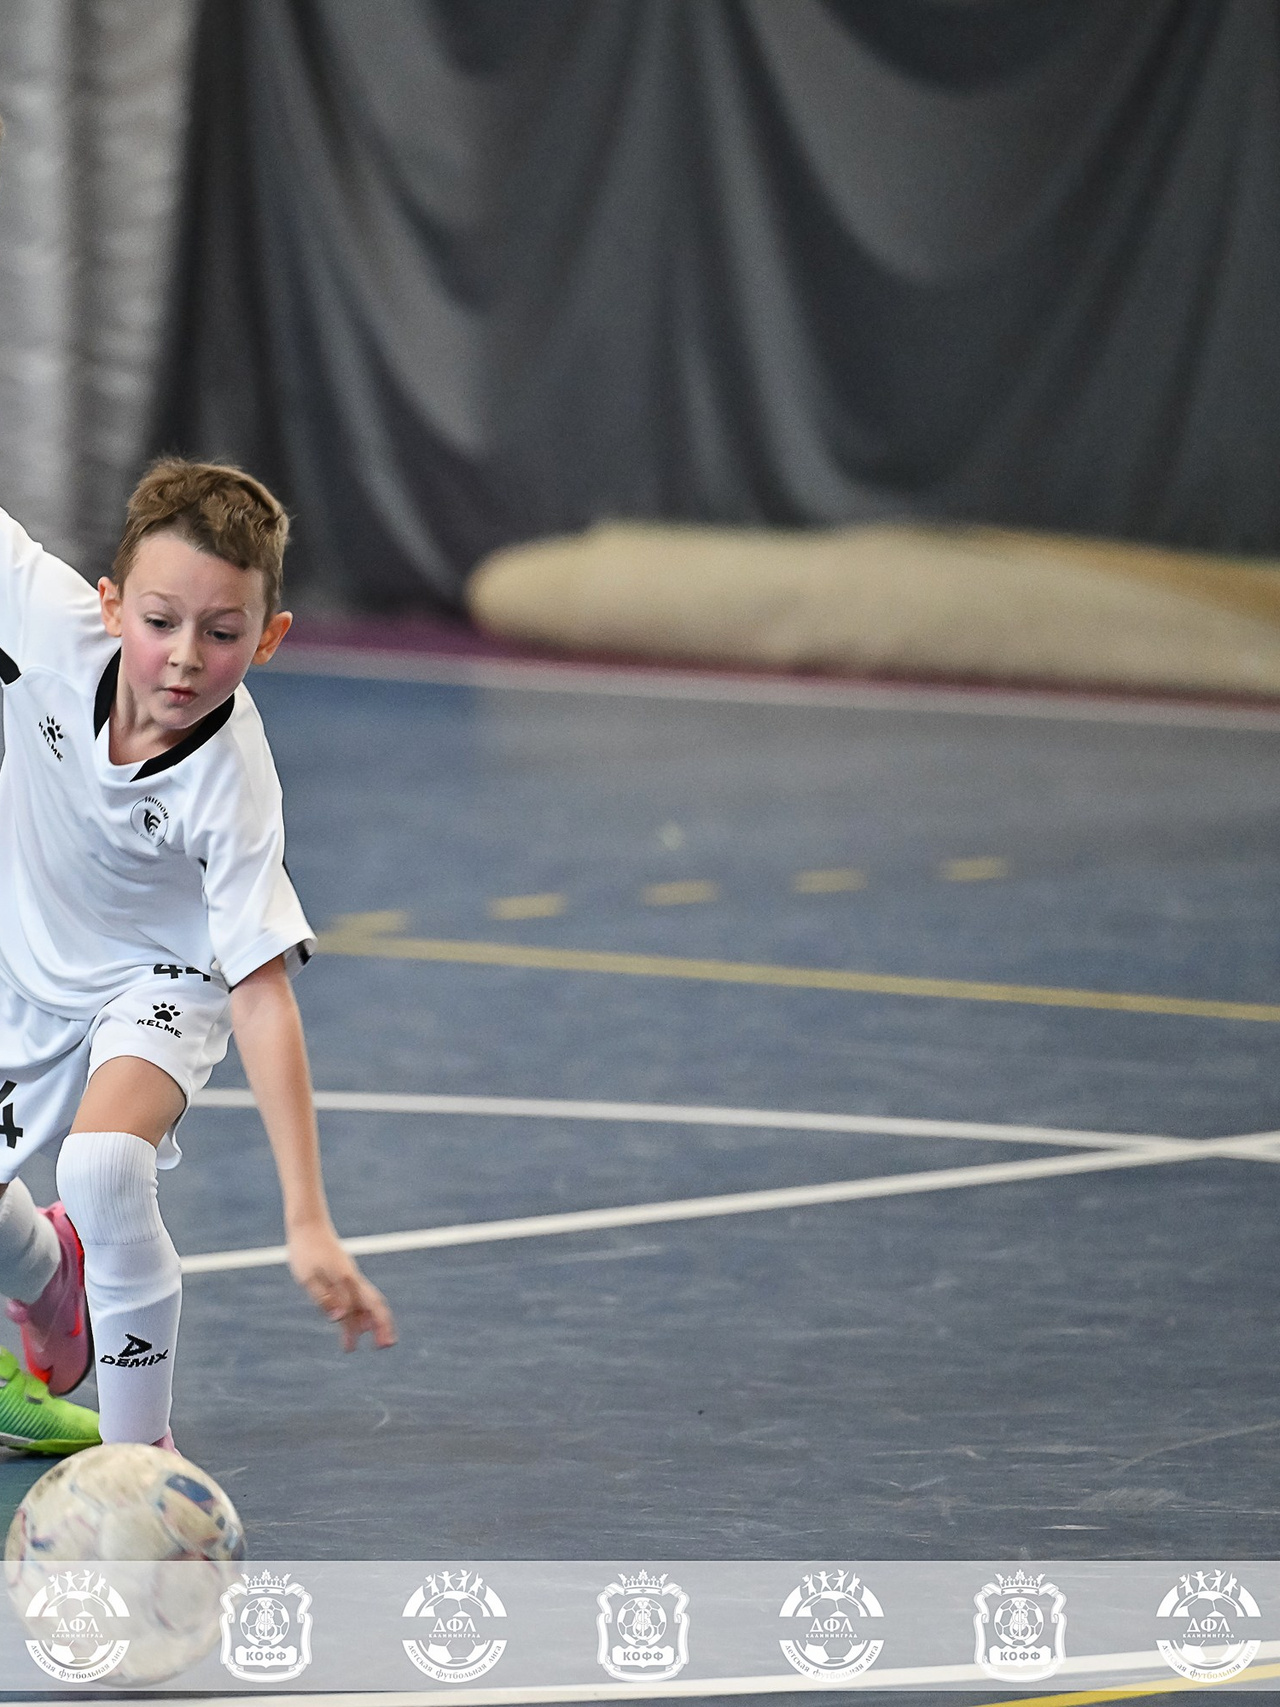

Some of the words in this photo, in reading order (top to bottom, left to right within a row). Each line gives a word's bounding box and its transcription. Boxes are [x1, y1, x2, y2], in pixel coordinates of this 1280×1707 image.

[38, 721, 64, 762] KELME
[136, 1018, 183, 1039] KELME
[100, 1348, 169, 1368] DEMIX
